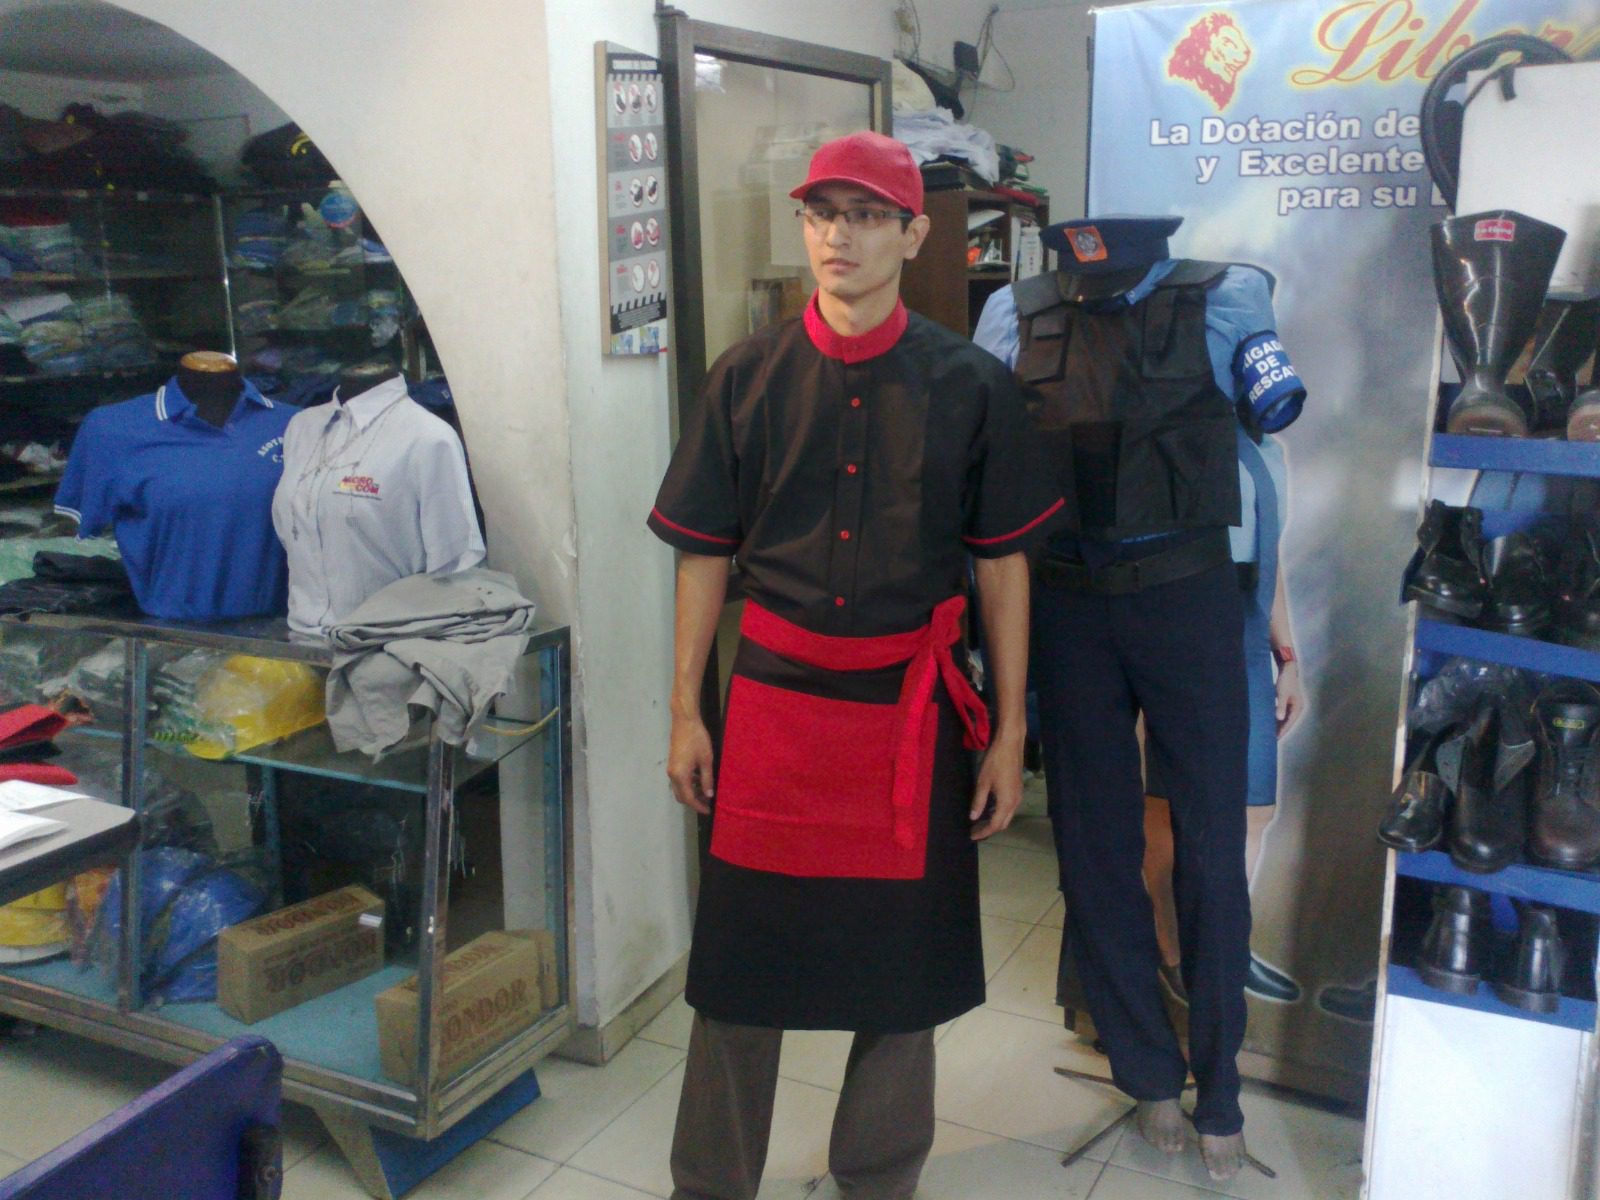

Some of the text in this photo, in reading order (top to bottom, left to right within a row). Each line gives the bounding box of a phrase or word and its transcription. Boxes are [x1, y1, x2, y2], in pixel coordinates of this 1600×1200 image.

[1150, 108, 1421, 146] La Dotación de
[1196, 145, 1425, 184] y Excelente
[1278, 186, 1361, 216] para
[1372, 185, 1417, 209] su
[1254, 354, 1280, 375] DE
